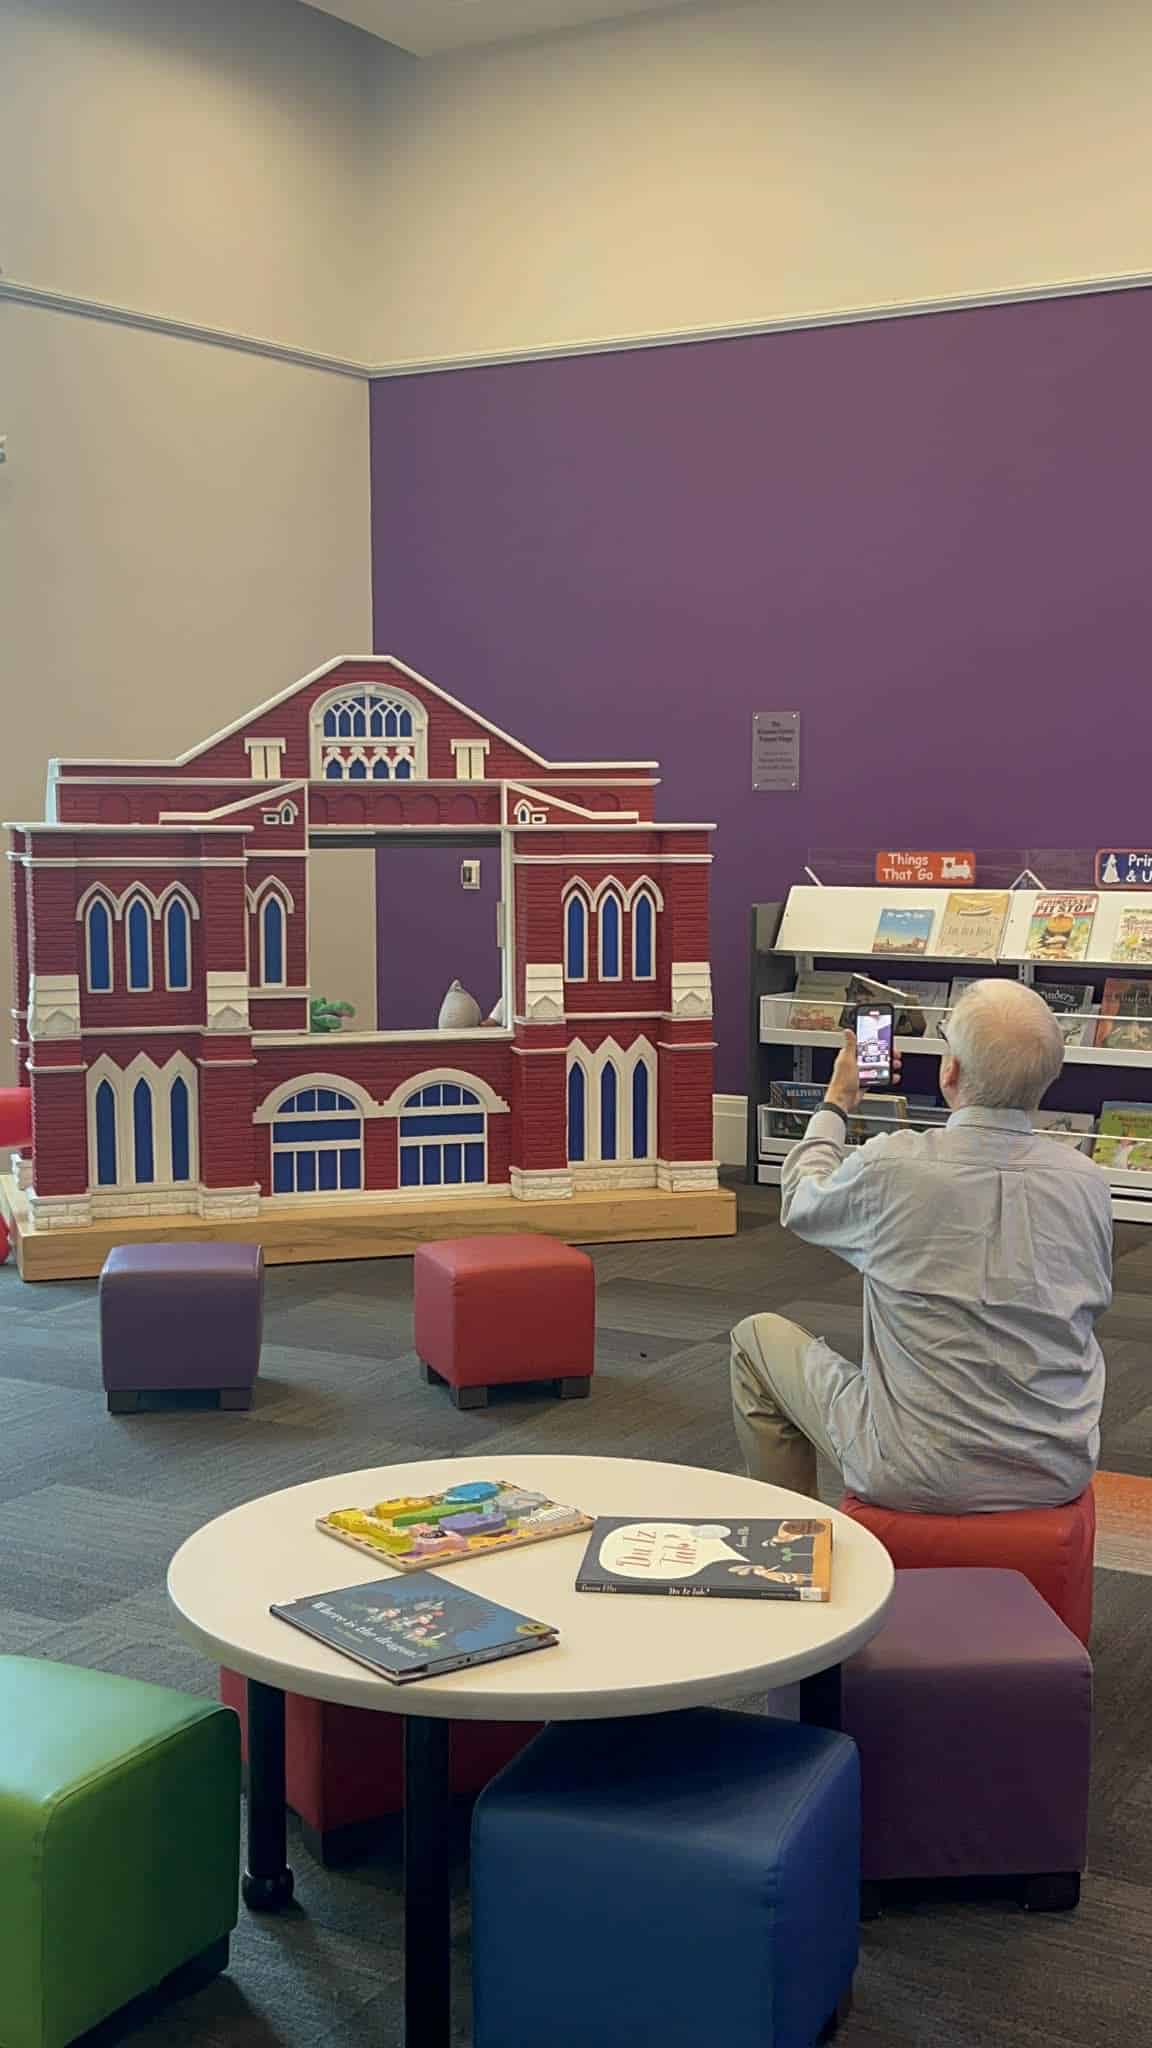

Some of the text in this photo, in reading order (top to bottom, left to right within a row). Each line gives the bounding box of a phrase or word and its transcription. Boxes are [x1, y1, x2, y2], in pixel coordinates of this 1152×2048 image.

[887, 853, 929, 868] Things
[882, 868, 934, 880] That Go
[1126, 870, 1136, 882] &
[616, 1529, 657, 1568] Du Iz
